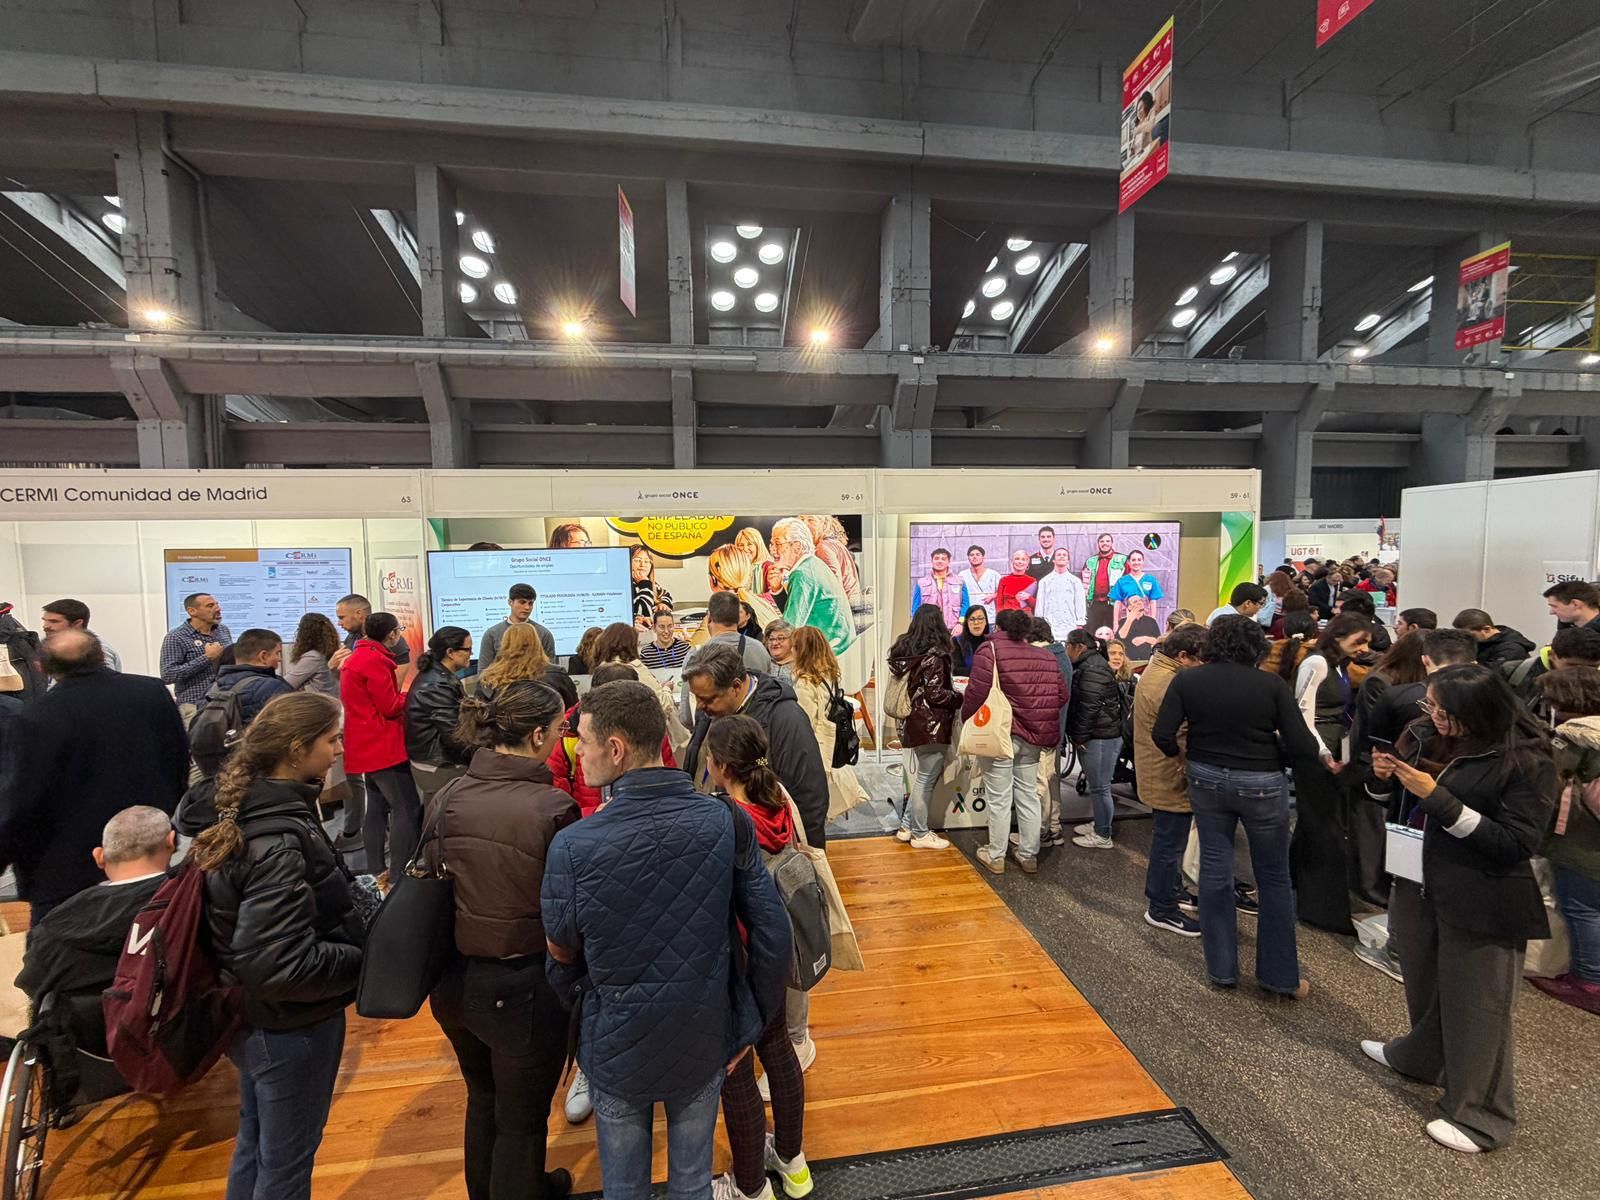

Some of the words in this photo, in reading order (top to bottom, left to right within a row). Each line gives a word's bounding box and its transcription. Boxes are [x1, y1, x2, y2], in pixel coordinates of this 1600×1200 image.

[0, 488, 58, 502] CERMI
[64, 487, 171, 501] Comunidad
[177, 488, 201, 501] de
[207, 486, 267, 501] Madrid
[672, 491, 699, 499] ONCE
[1090, 487, 1112, 495] ONCE
[401, 495, 411, 504] 63
[841, 493, 850, 501] 59
[856, 493, 864, 501] 61
[648, 523, 663, 531] NO
[665, 521, 708, 531] PÚBLICO
[648, 532, 662, 540] DE
[664, 531, 703, 540] ESPAÑA
[1291, 547, 1308, 556] UGT
